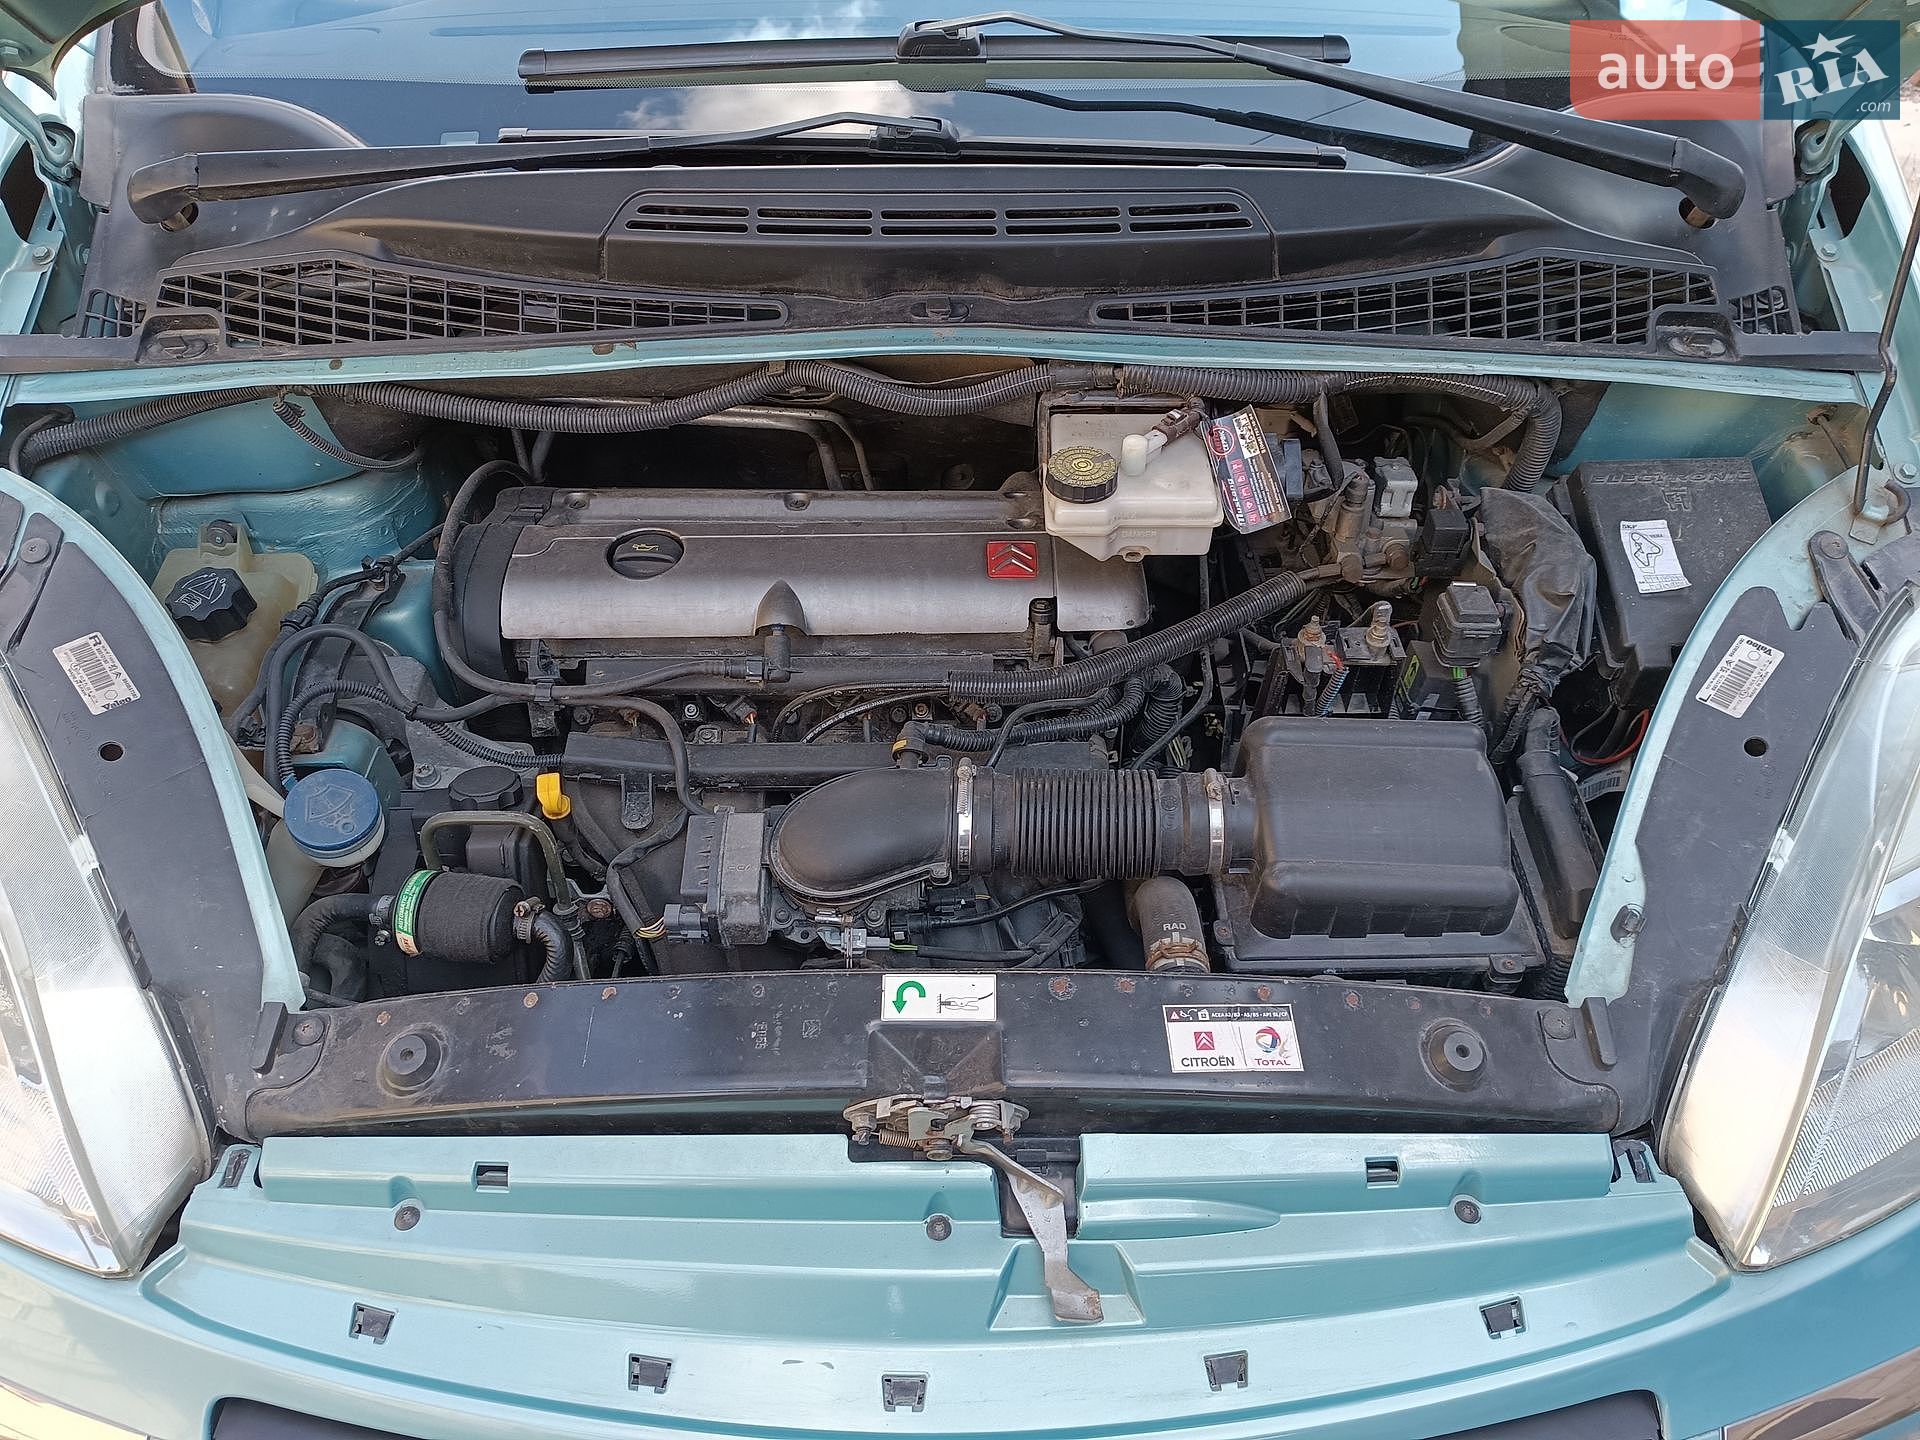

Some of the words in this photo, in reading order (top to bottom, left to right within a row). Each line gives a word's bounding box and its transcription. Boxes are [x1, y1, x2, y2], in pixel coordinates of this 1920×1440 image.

[1590, 470, 1752, 485] ELECTRONIC
[1227, 478, 1247, 526] Mustang
[88, 634, 102, 647] R
[1745, 639, 1773, 657] Valeo
[101, 696, 132, 710] Valeo
[1698, 693, 1712, 702] L
[1162, 922, 1187, 931] RAD
[1181, 1055, 1235, 1067] CITROËN
